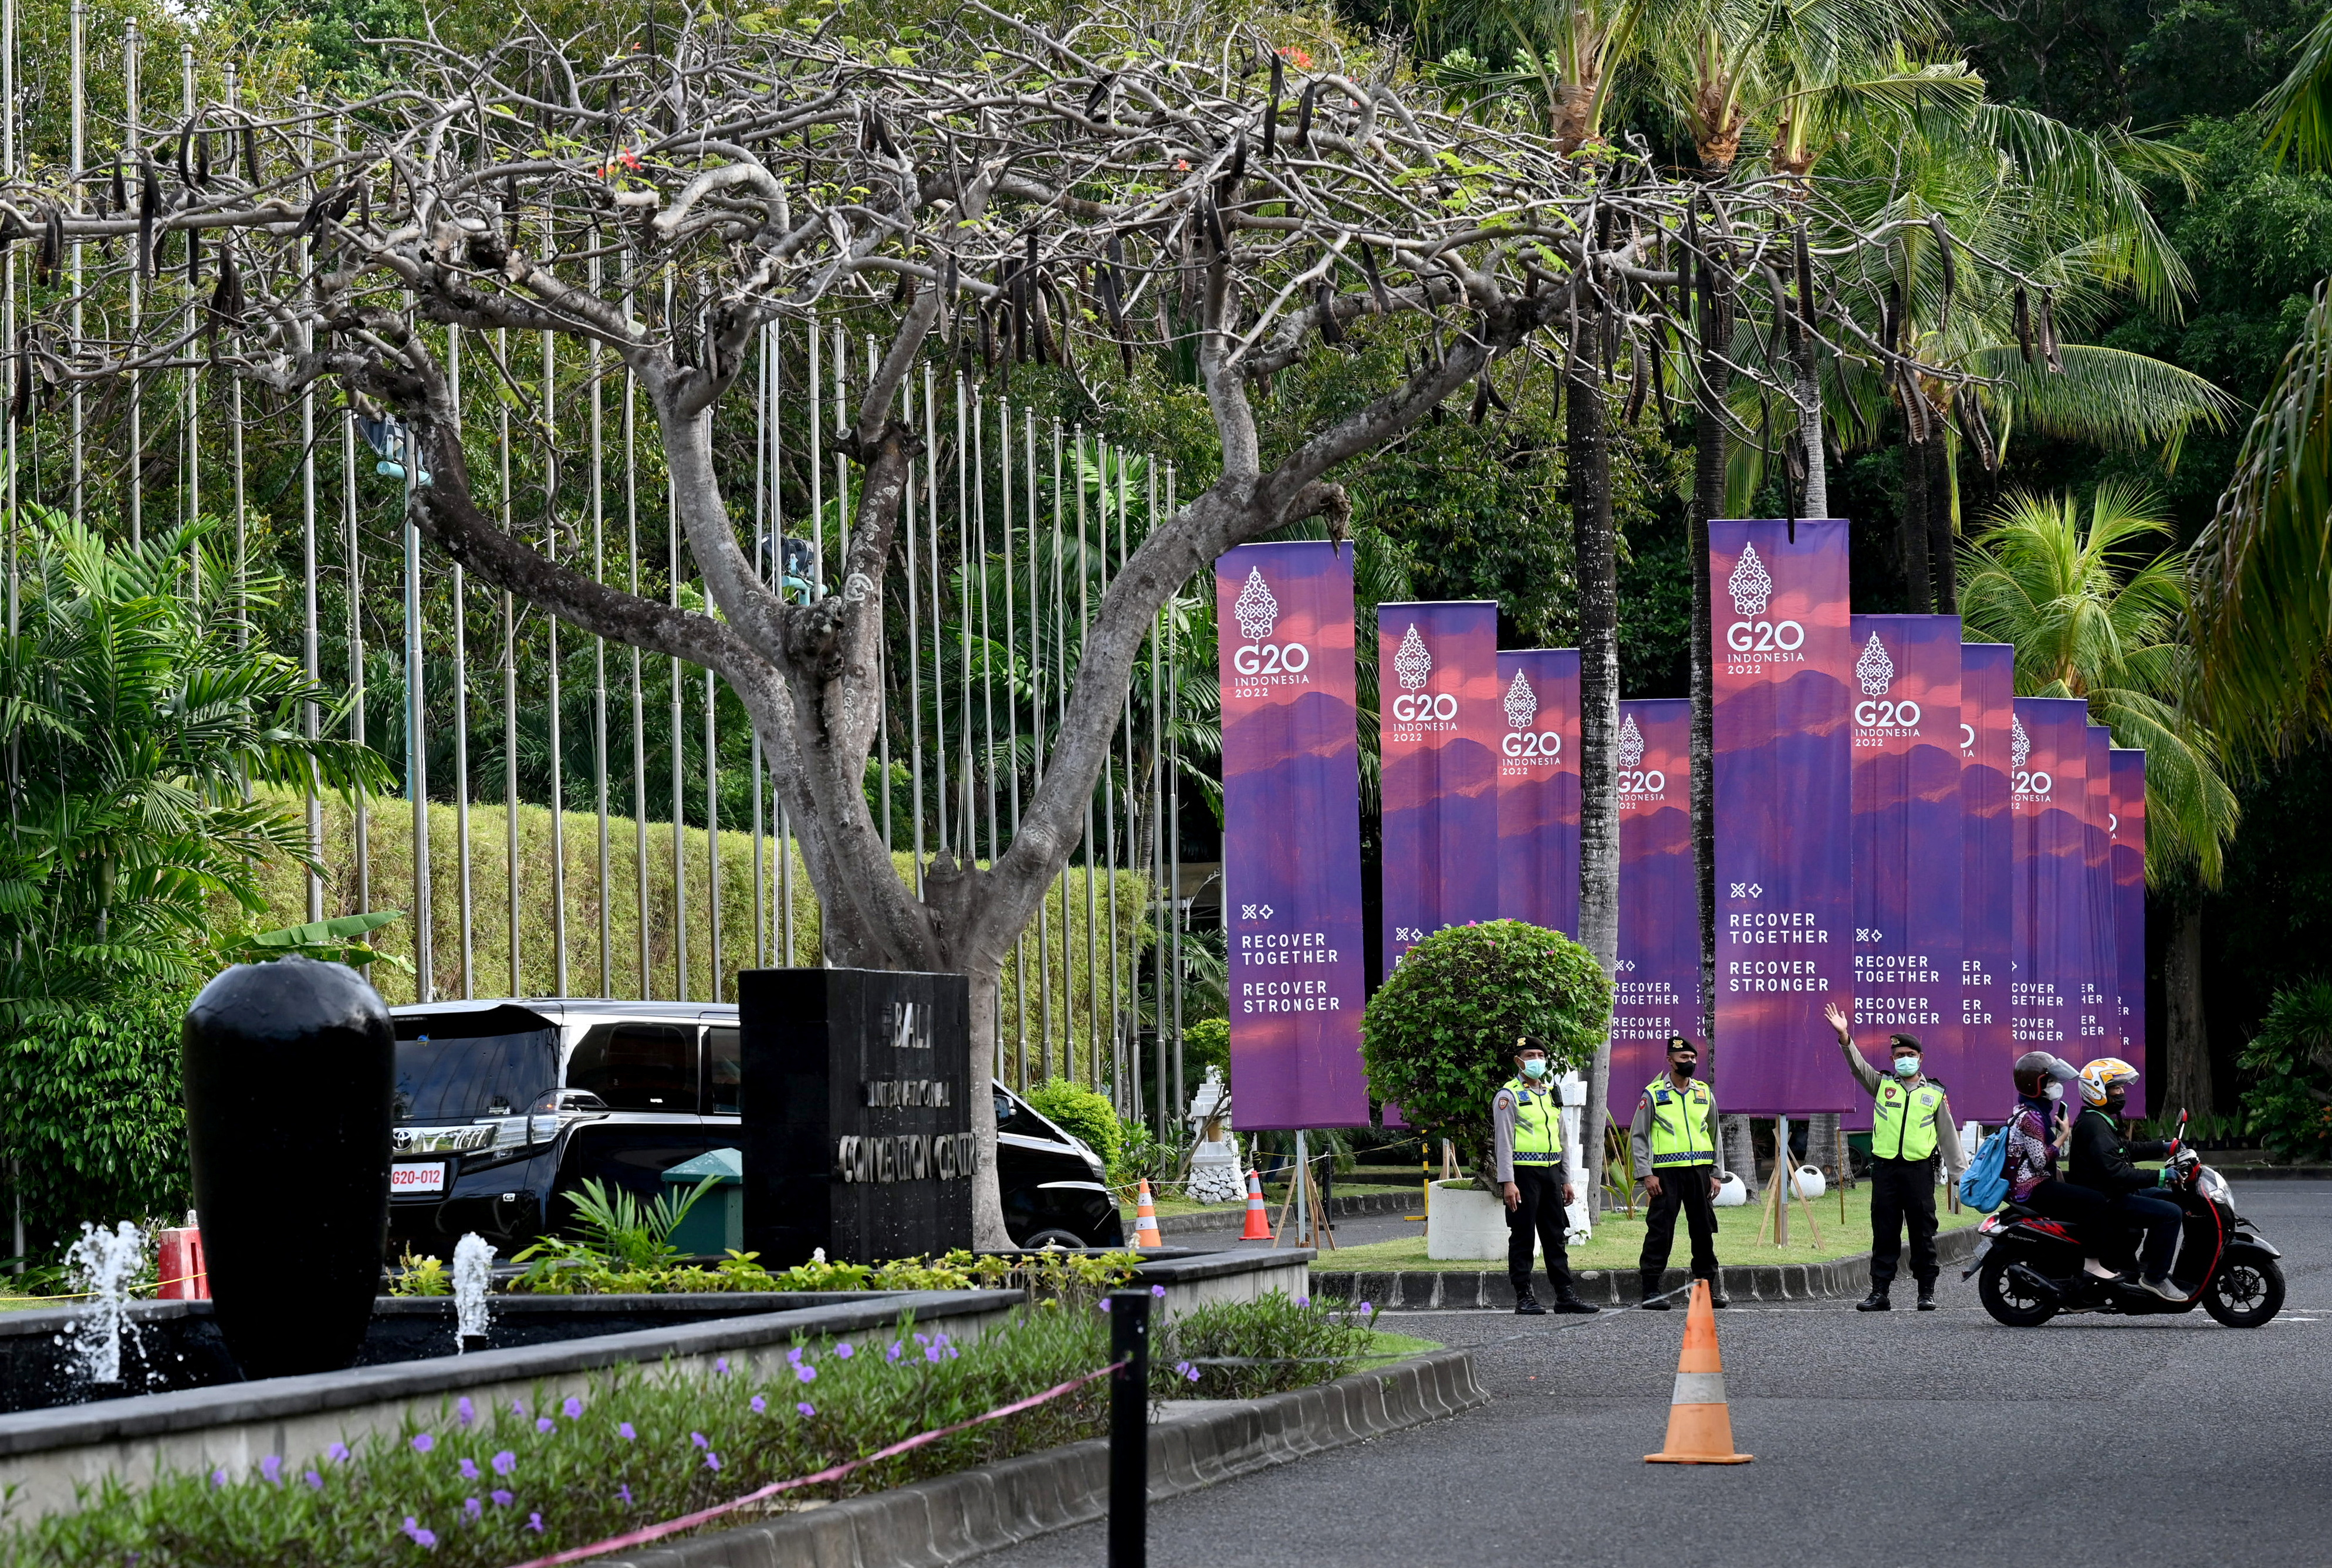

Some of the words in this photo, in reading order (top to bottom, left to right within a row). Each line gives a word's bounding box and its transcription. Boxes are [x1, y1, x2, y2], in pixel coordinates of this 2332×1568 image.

[1728, 621, 1804, 651] G20
[1234, 643, 1309, 674] G20
[1728, 653, 1804, 663] INDONESIA
[1728, 665, 1760, 674] 2022
[1235, 675, 1309, 687] INDONESIA
[1236, 688, 1268, 697] 2022
[1393, 694, 1457, 721] G20
[1855, 701, 1920, 726] G20
[1394, 722, 1457, 731] INDONESIA
[1502, 732, 1560, 756] G20
[1503, 758, 1560, 766] INDONESIA
[1619, 771, 1664, 793] G20
[2012, 771, 2051, 793] 20
[1731, 914, 1814, 927] RECOVER
[1242, 933, 1324, 948] RECOVER
[1730, 931, 1827, 944] TOGETHER
[1242, 950, 1337, 965] TOGETHER
[1856, 956, 1927, 967] RECOVER
[1731, 961, 1815, 974] RECOVER
[1855, 971, 1938, 982] TOGETHER
[1244, 981, 1326, 995] RECOVER
[1614, 983, 1671, 992] RECOVER
[1730, 979, 1828, 991] STRONGER
[1244, 998, 1339, 1012] STRONGER
[1613, 995, 1679, 1004] TOGETHER
[1856, 998, 1928, 1009] RECOVER
[1613, 1018, 1671, 1026] RECOVER
[1855, 1013, 1939, 1024] STRONGER
[890, 1002, 931, 1049] BALI
[1613, 1030, 1679, 1039] STRONGER
[868, 1080, 950, 1108] INTERNATIONAL
[839, 1135, 932, 1183] CONVENTION
[934, 1133, 979, 1181] CENTR
[393, 1170, 440, 1184] G20-012
